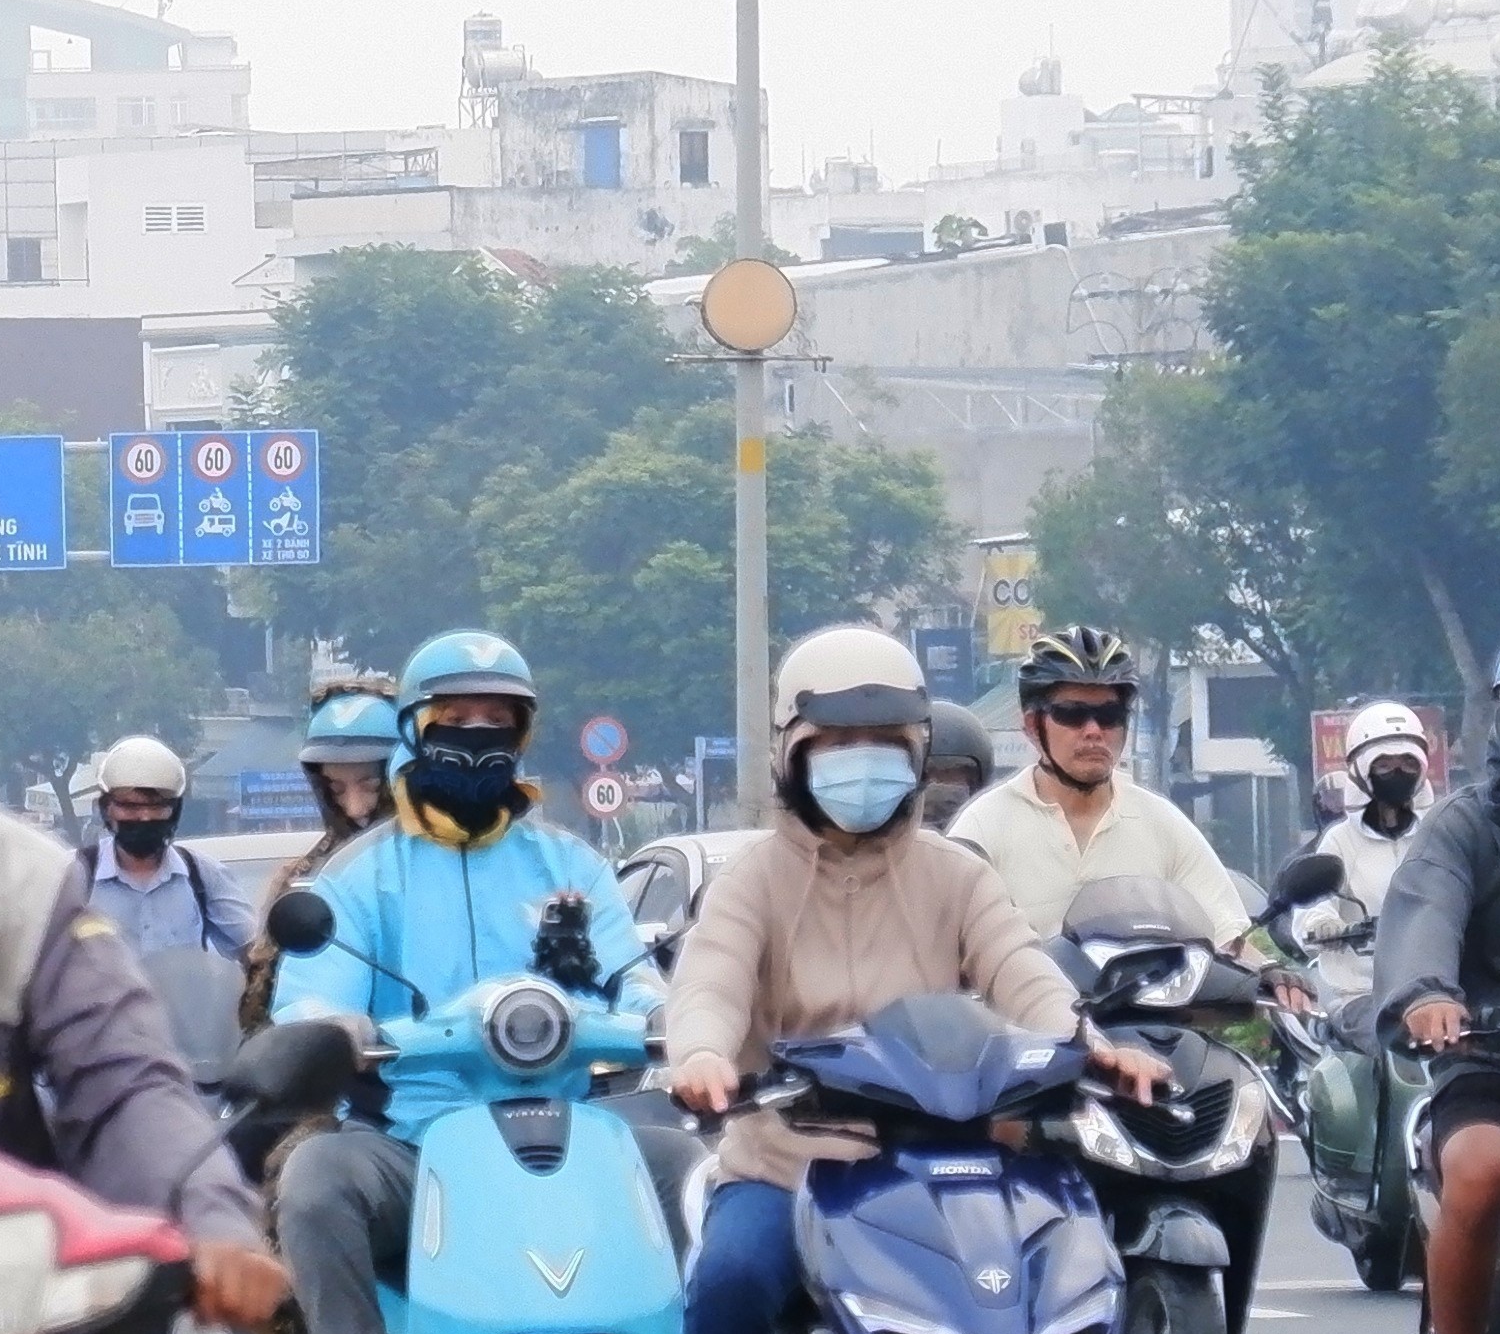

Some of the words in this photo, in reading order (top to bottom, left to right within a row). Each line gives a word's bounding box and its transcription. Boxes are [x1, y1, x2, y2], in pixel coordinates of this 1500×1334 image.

[134, 448, 154, 473] 60
[204, 447, 224, 472] 60
[273, 445, 293, 470] 60
[7, 540, 48, 561] TĨNH
[596, 784, 615, 805] 60
[932, 1165, 993, 1176] HONDA
